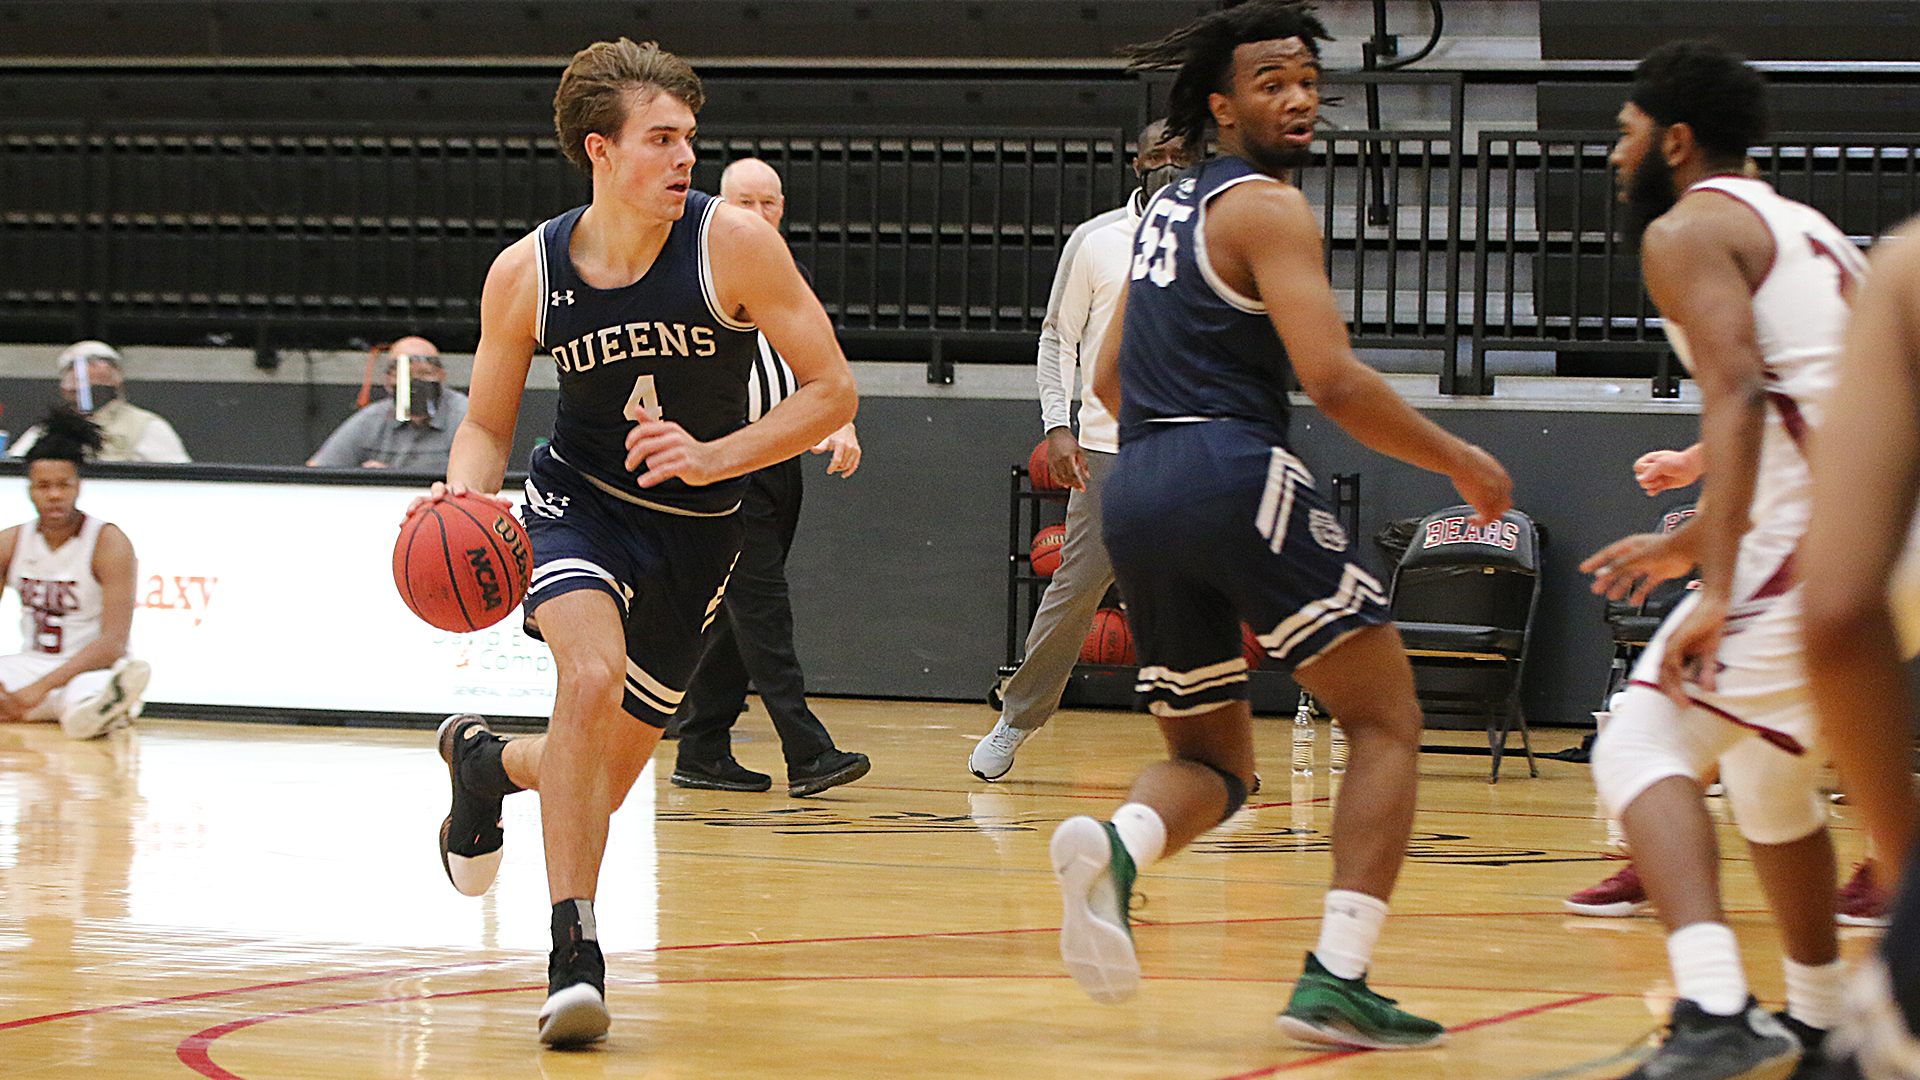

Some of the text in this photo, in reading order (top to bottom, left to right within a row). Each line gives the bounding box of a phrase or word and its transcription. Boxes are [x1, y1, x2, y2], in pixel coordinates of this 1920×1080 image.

[551, 321, 717, 373] QUEENS
[623, 374, 664, 423] 4
[1422, 516, 1521, 551] BEARS
[466, 546, 502, 612] NCAA
